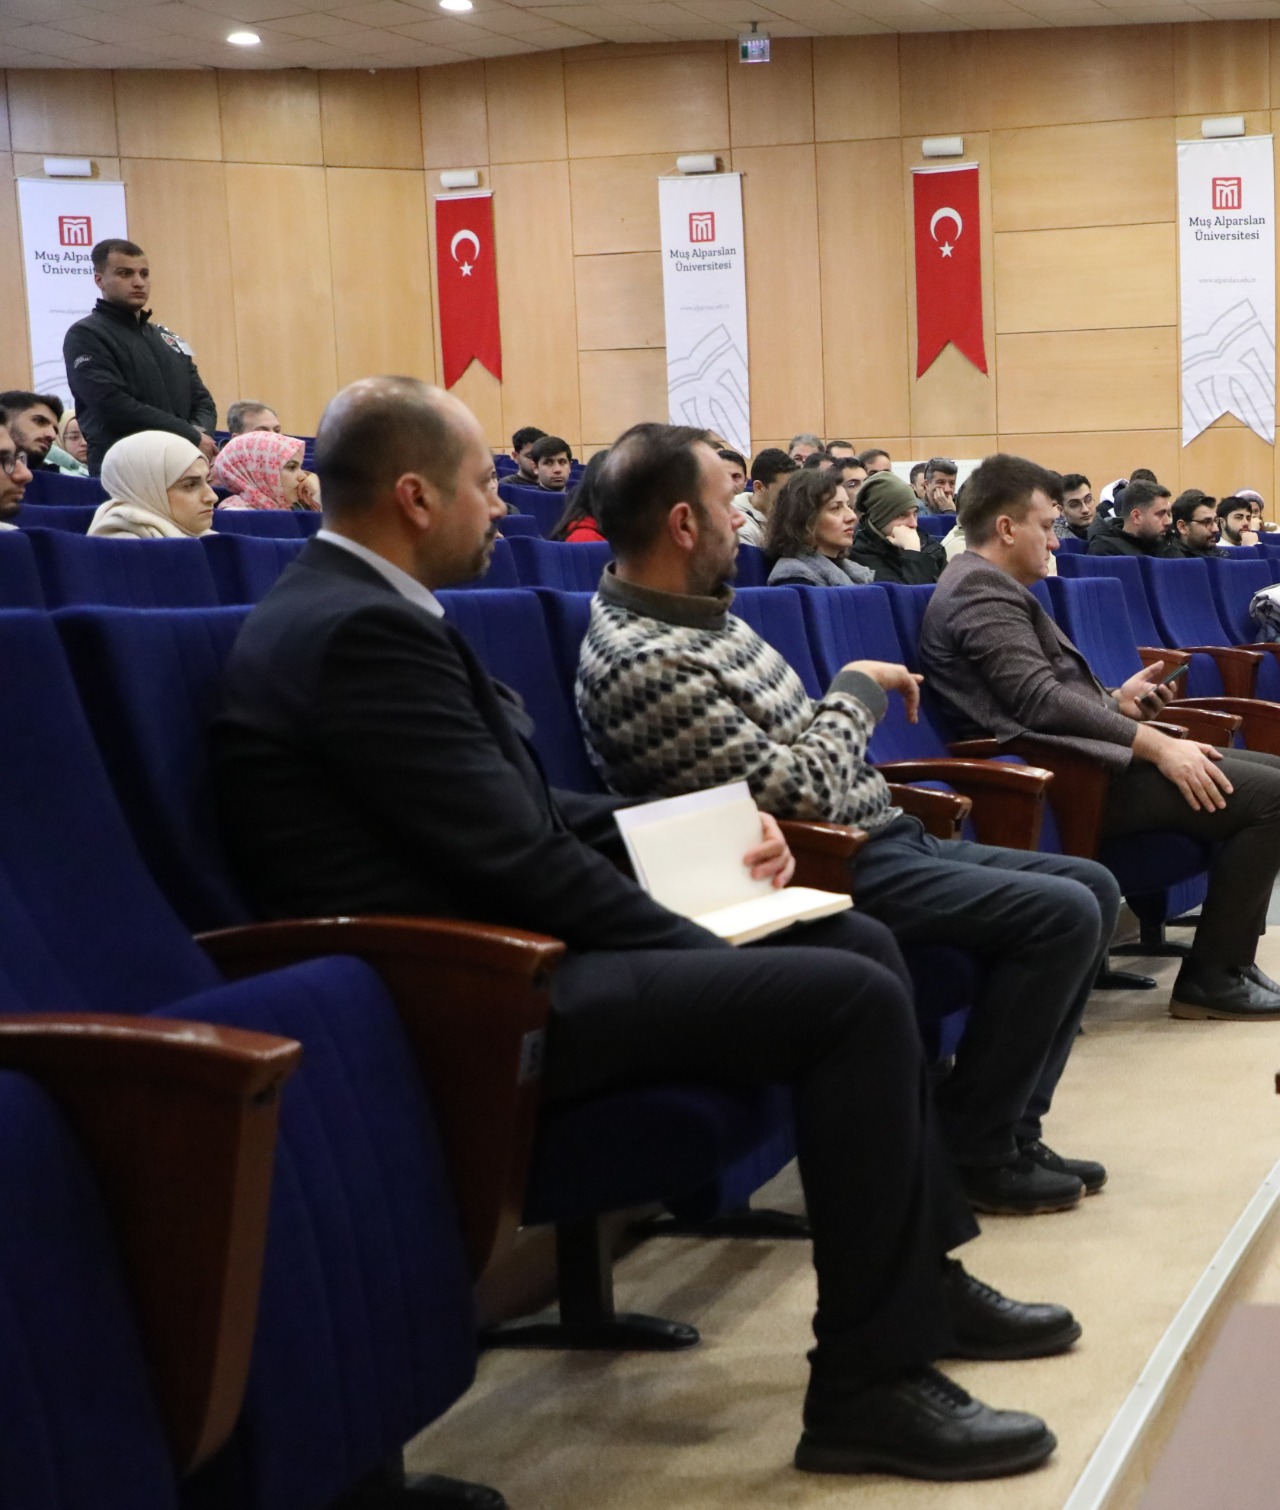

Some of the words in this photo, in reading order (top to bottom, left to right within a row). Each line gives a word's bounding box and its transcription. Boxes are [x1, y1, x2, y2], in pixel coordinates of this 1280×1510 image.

[1189, 217, 1212, 228] Muş
[1214, 215, 1266, 228] Alparslan
[1195, 229, 1260, 241] Üniversitesi
[35, 250, 60, 262] Muş
[669, 249, 690, 260] Muş
[691, 246, 737, 260] Alparslan
[675, 260, 732, 272] Üniversitesi
